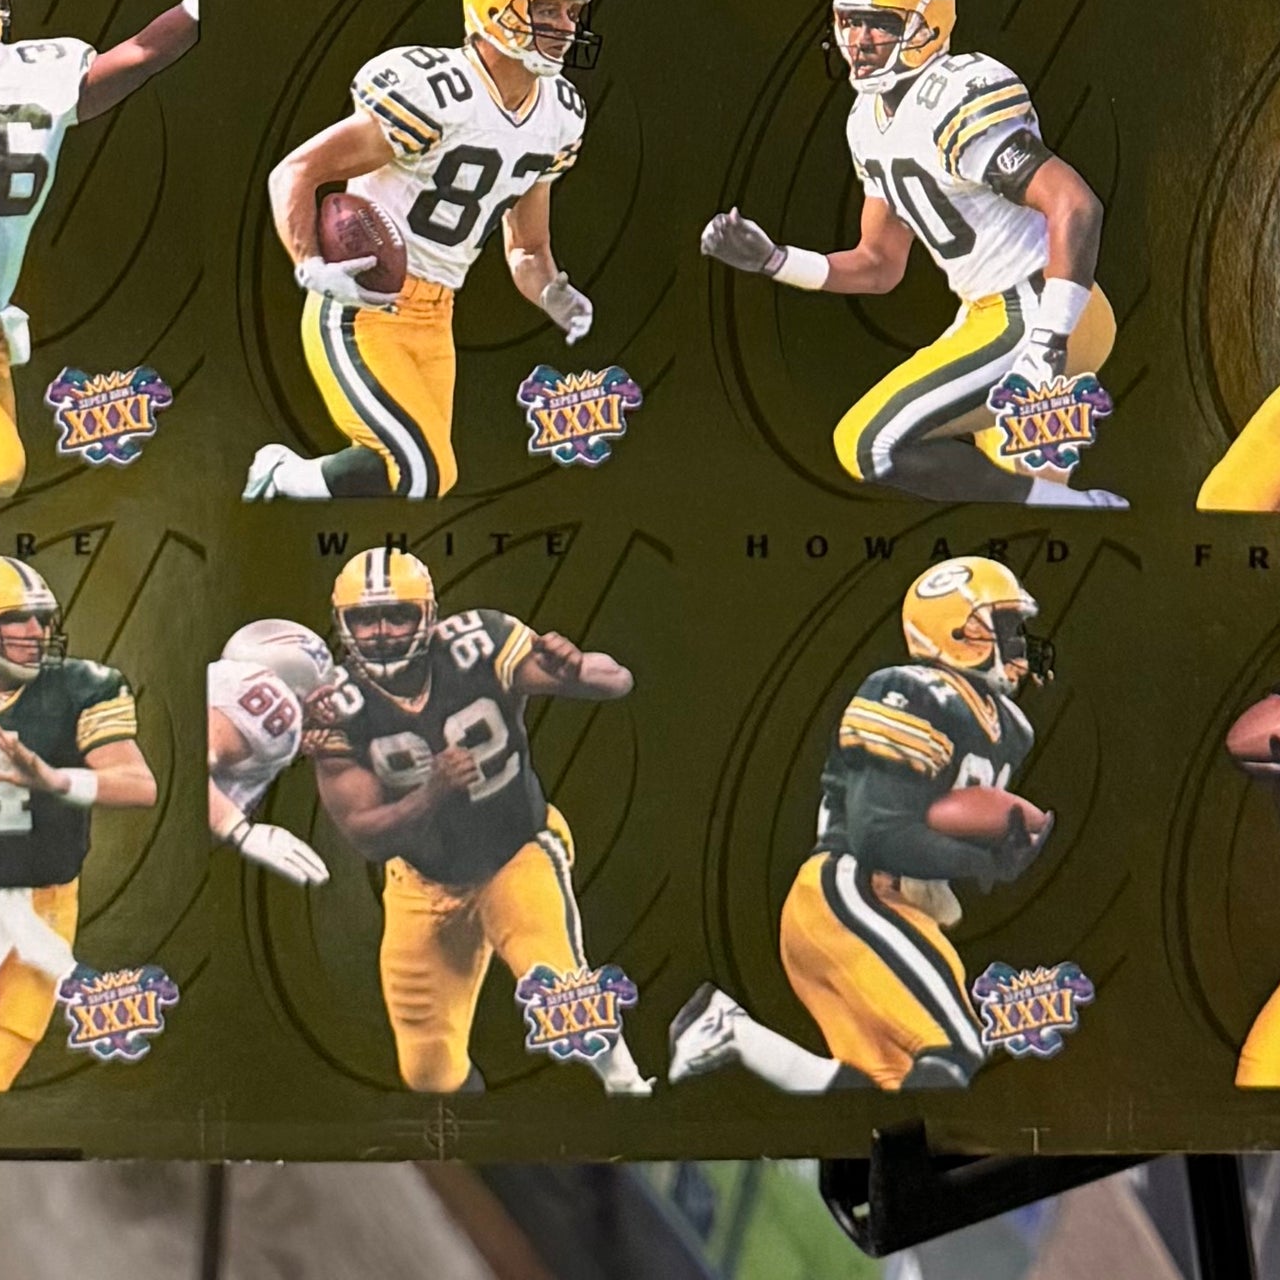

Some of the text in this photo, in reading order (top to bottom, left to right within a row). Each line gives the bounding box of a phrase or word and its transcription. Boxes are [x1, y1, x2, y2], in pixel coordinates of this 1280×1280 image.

[65, 395, 151, 445] XXXI
[536, 395, 621, 445] XXXI
[1005, 403, 1092, 452] XXXI
[318, 532, 568, 557] WHITE
[746, 535, 1068, 563] HOWARD
[74, 992, 159, 1040] XXXI
[533, 992, 617, 1041] XXXI
[990, 990, 1073, 1037] XXXI
